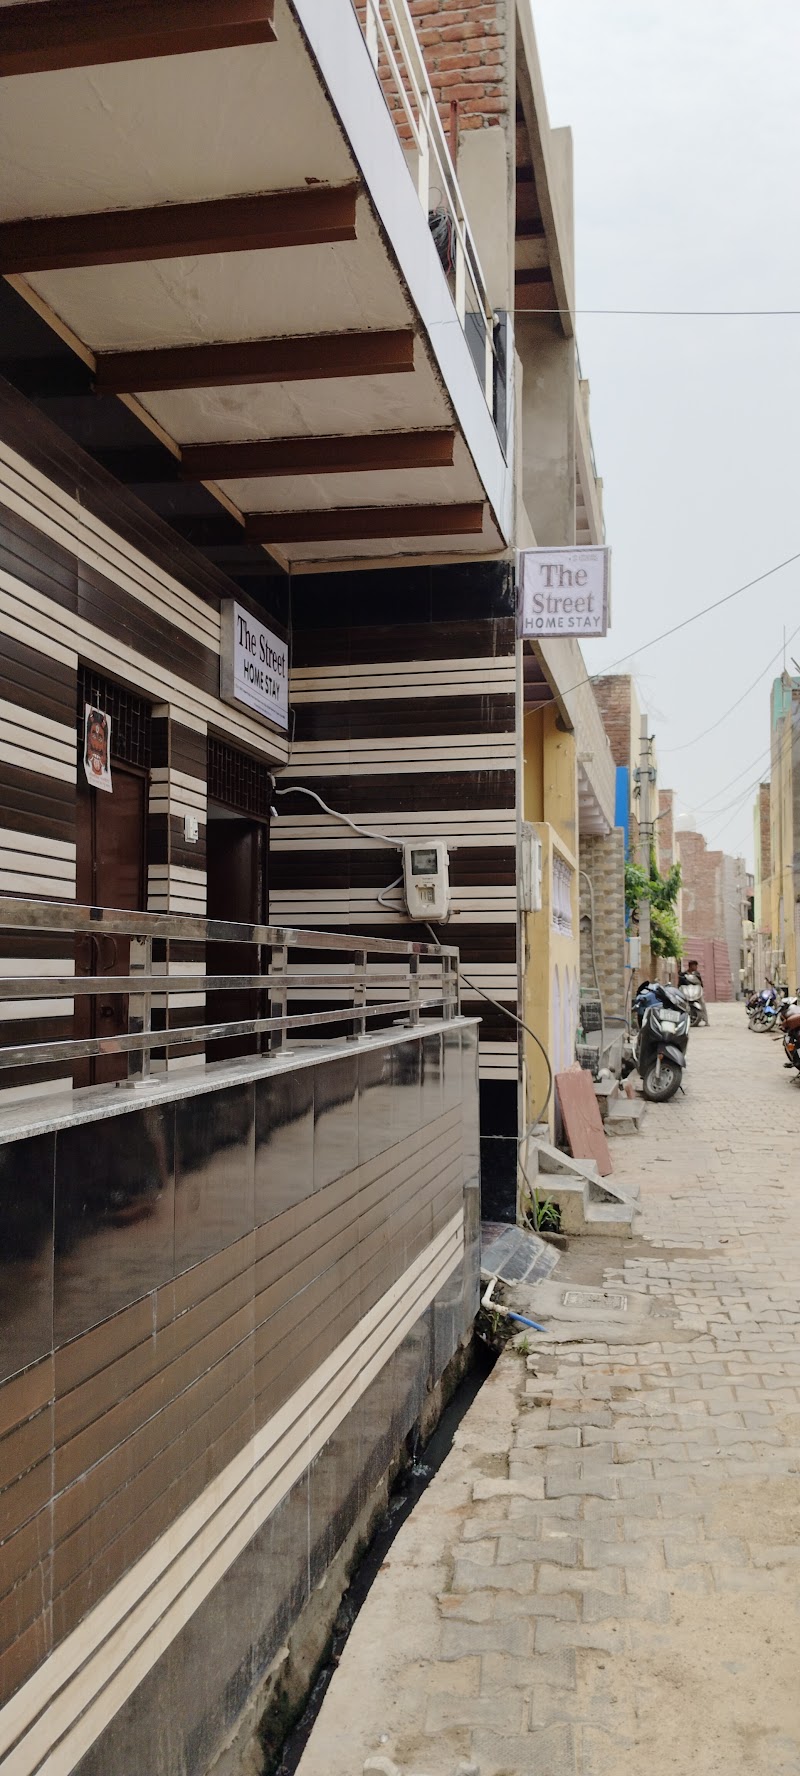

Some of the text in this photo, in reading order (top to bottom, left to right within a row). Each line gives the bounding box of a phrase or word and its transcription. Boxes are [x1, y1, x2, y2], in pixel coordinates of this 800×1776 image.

[540, 563, 588, 588] The
[532, 591, 595, 614] Street
[525, 616, 601, 629] HOME STAY
[237, 614, 286, 678] The Street
[243, 658, 264, 690] HOME
[264, 674, 281, 701] STAY
